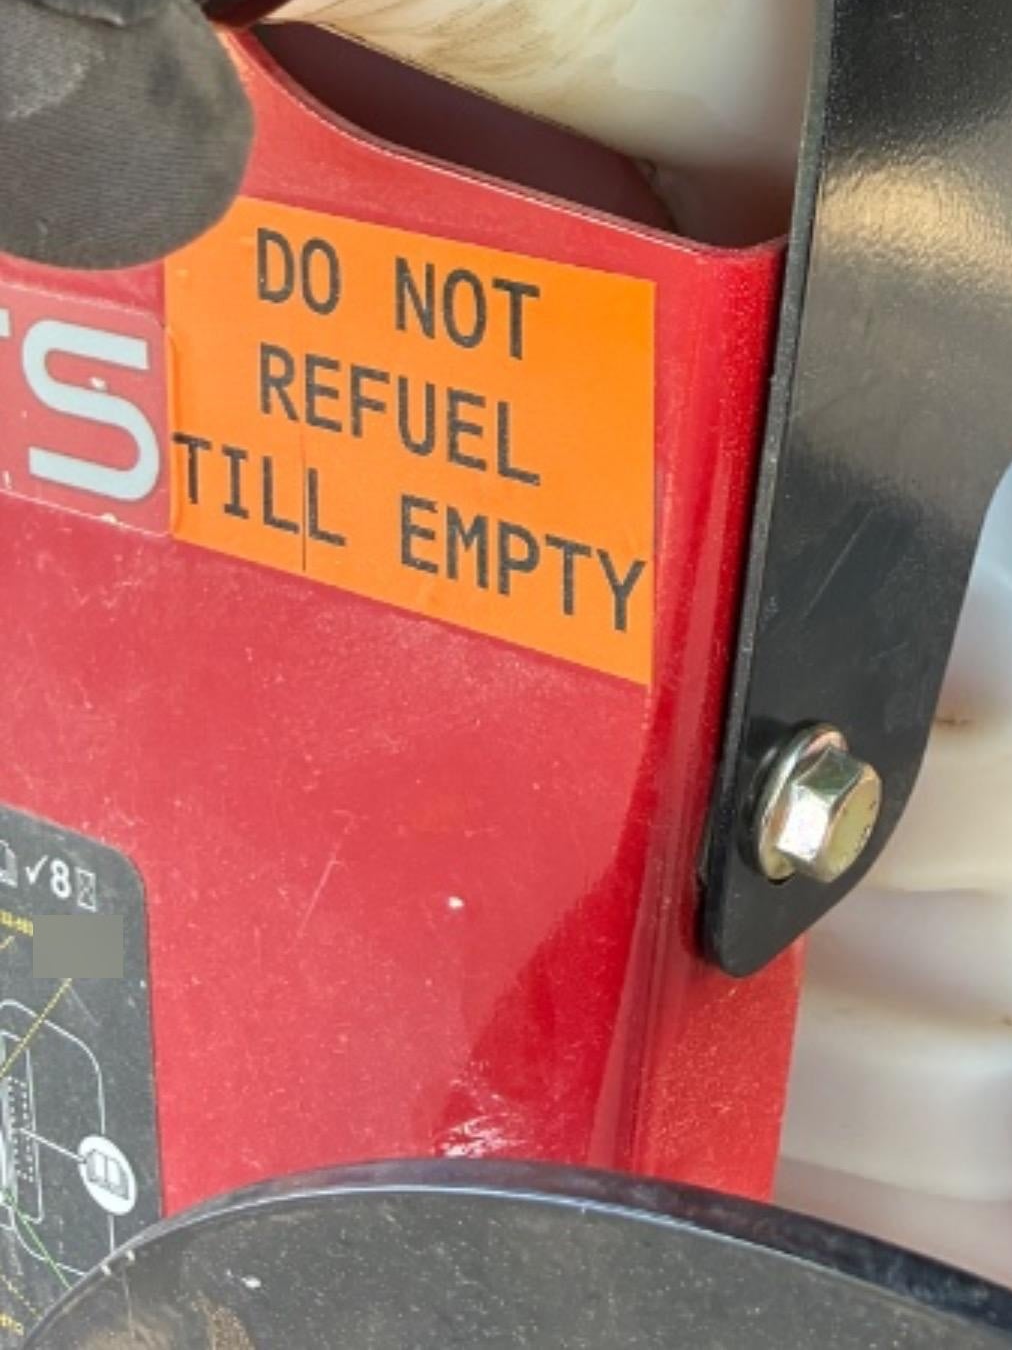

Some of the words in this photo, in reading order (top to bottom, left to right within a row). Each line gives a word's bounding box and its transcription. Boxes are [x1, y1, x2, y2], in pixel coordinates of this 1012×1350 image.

[256, 226, 341, 316] DO
[394, 256, 541, 360] NOT
[0, 308, 160, 501] S
[259, 340, 541, 486] REFUEL
[172, 431, 347, 547] TILL
[400, 493, 647, 632] EMPTY
[50, 858, 72, 899] 8
